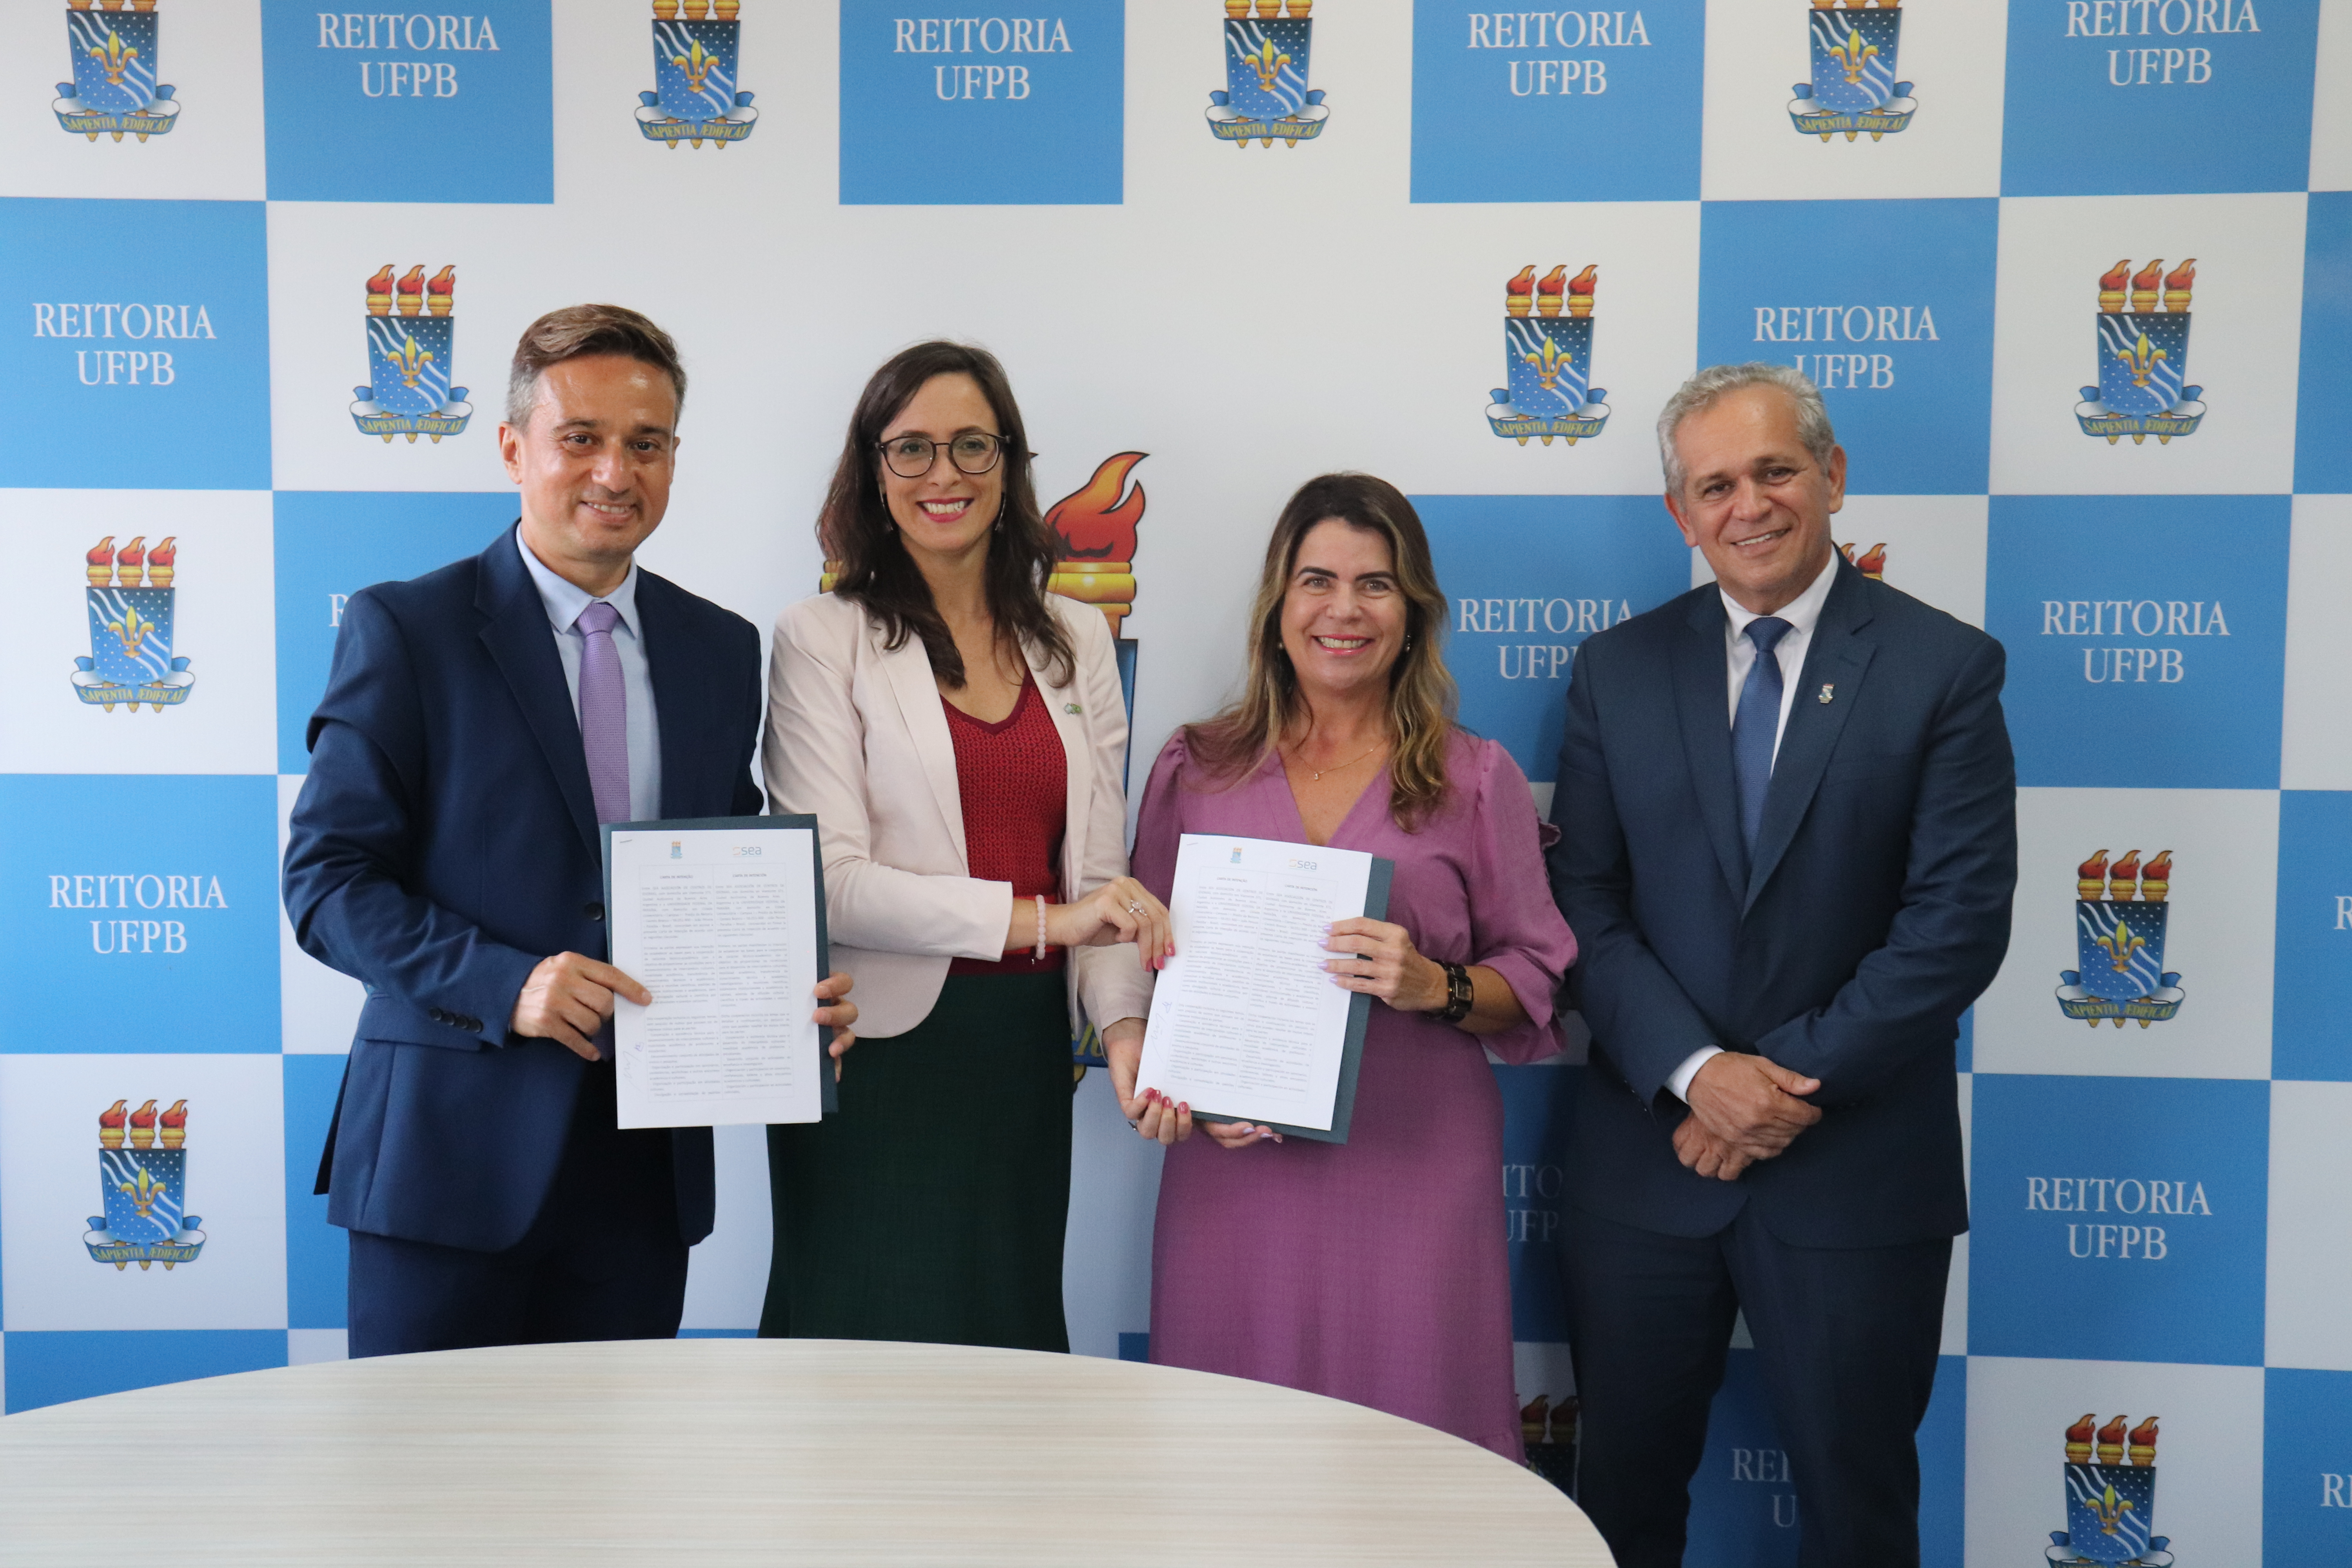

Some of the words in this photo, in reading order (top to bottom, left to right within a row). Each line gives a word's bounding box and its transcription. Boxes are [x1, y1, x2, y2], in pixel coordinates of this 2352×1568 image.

[317, 13, 500, 51] REITORIA
[894, 18, 1073, 53] REITORIA
[1467, 11, 1651, 48] REITORIA
[2065, 0, 2261, 37] REITORIA
[360, 62, 458, 98] UFPB
[935, 65, 1030, 100] UFPB
[1508, 60, 1607, 96] UFPB
[2107, 47, 2212, 86] UFPB
[62, 116, 117, 131] SAPIENTIA
[644, 124, 697, 138] SAPIENTIA
[1213, 123, 1267, 137] SAPIENTIA
[1797, 117, 1852, 131] SAPIENTIA
[33, 303, 216, 339] REITORIA
[1753, 306, 1940, 342] REITORIA
[76, 351, 175, 386] UFPB
[358, 419, 412, 432] SAPIENTIA
[1494, 421, 1548, 435] SAPIENTIA
[2083, 419, 2140, 434] SAPIENTIA
[2042, 600, 2230, 636] REITORIA
[1497, 645, 1577, 679] UFP
[2082, 648, 2184, 683] UFPB
[80, 688, 133, 702] SAPIENTIA
[741, 847, 761, 855] sea
[1297, 860, 1318, 871] sea
[49, 874, 228, 909] REITORIA
[90, 920, 187, 954] UFPB
[2025, 1177, 2212, 1216] REITORIA
[2067, 1225, 2167, 1260] UFPB
